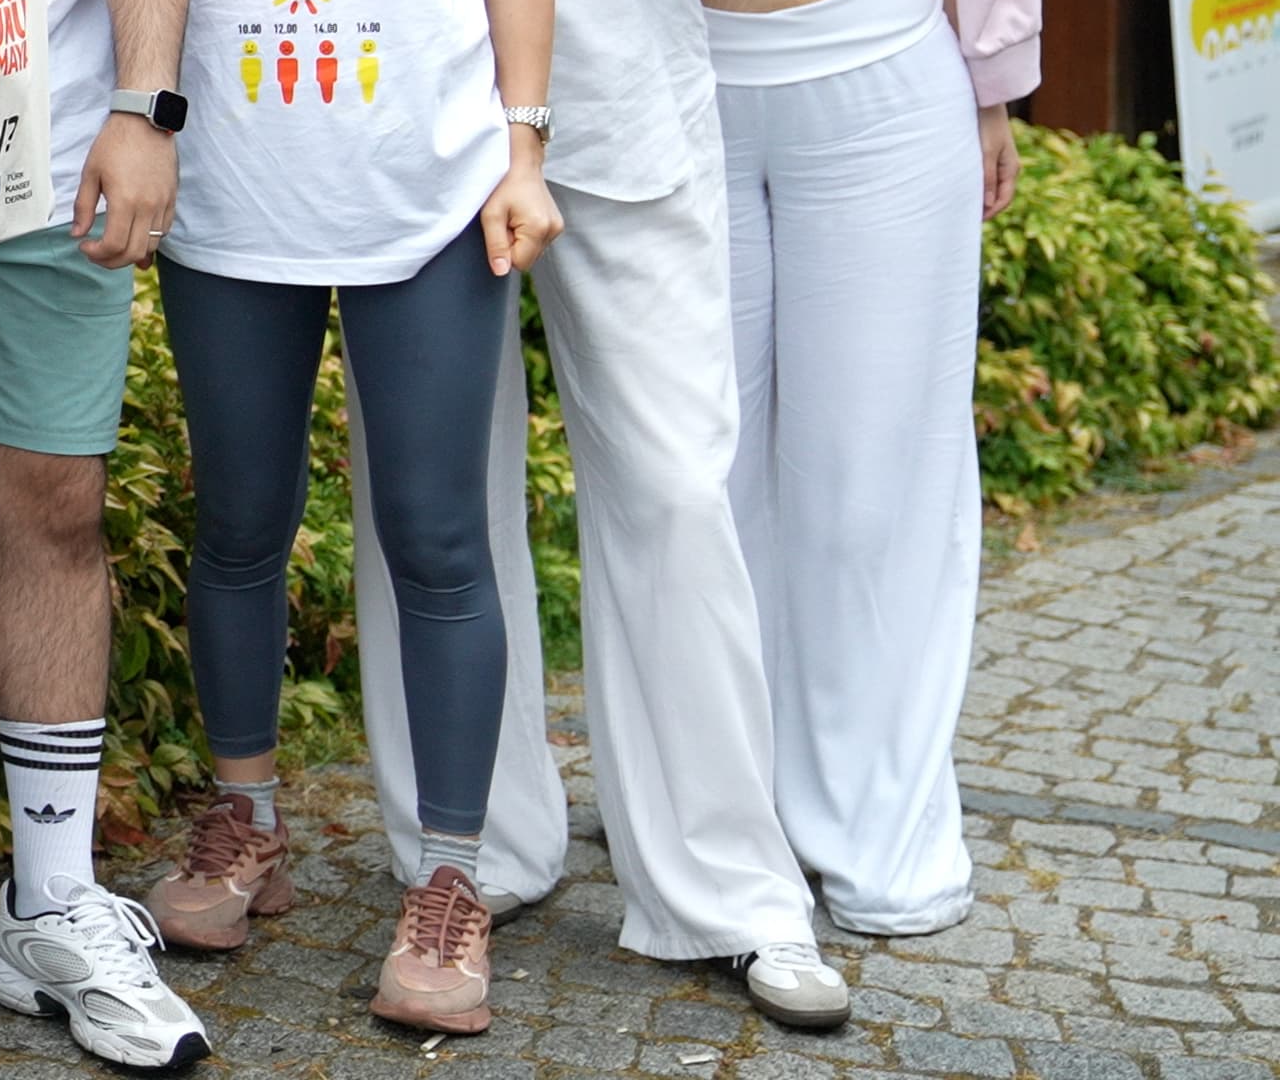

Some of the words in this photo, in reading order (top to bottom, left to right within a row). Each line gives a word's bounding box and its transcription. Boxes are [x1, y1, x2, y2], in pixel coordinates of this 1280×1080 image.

[238, 23, 262, 34] 10.00
[274, 23, 298, 34] 12.00
[314, 23, 338, 34] 14.00
[357, 22, 381, 33] 16.00
